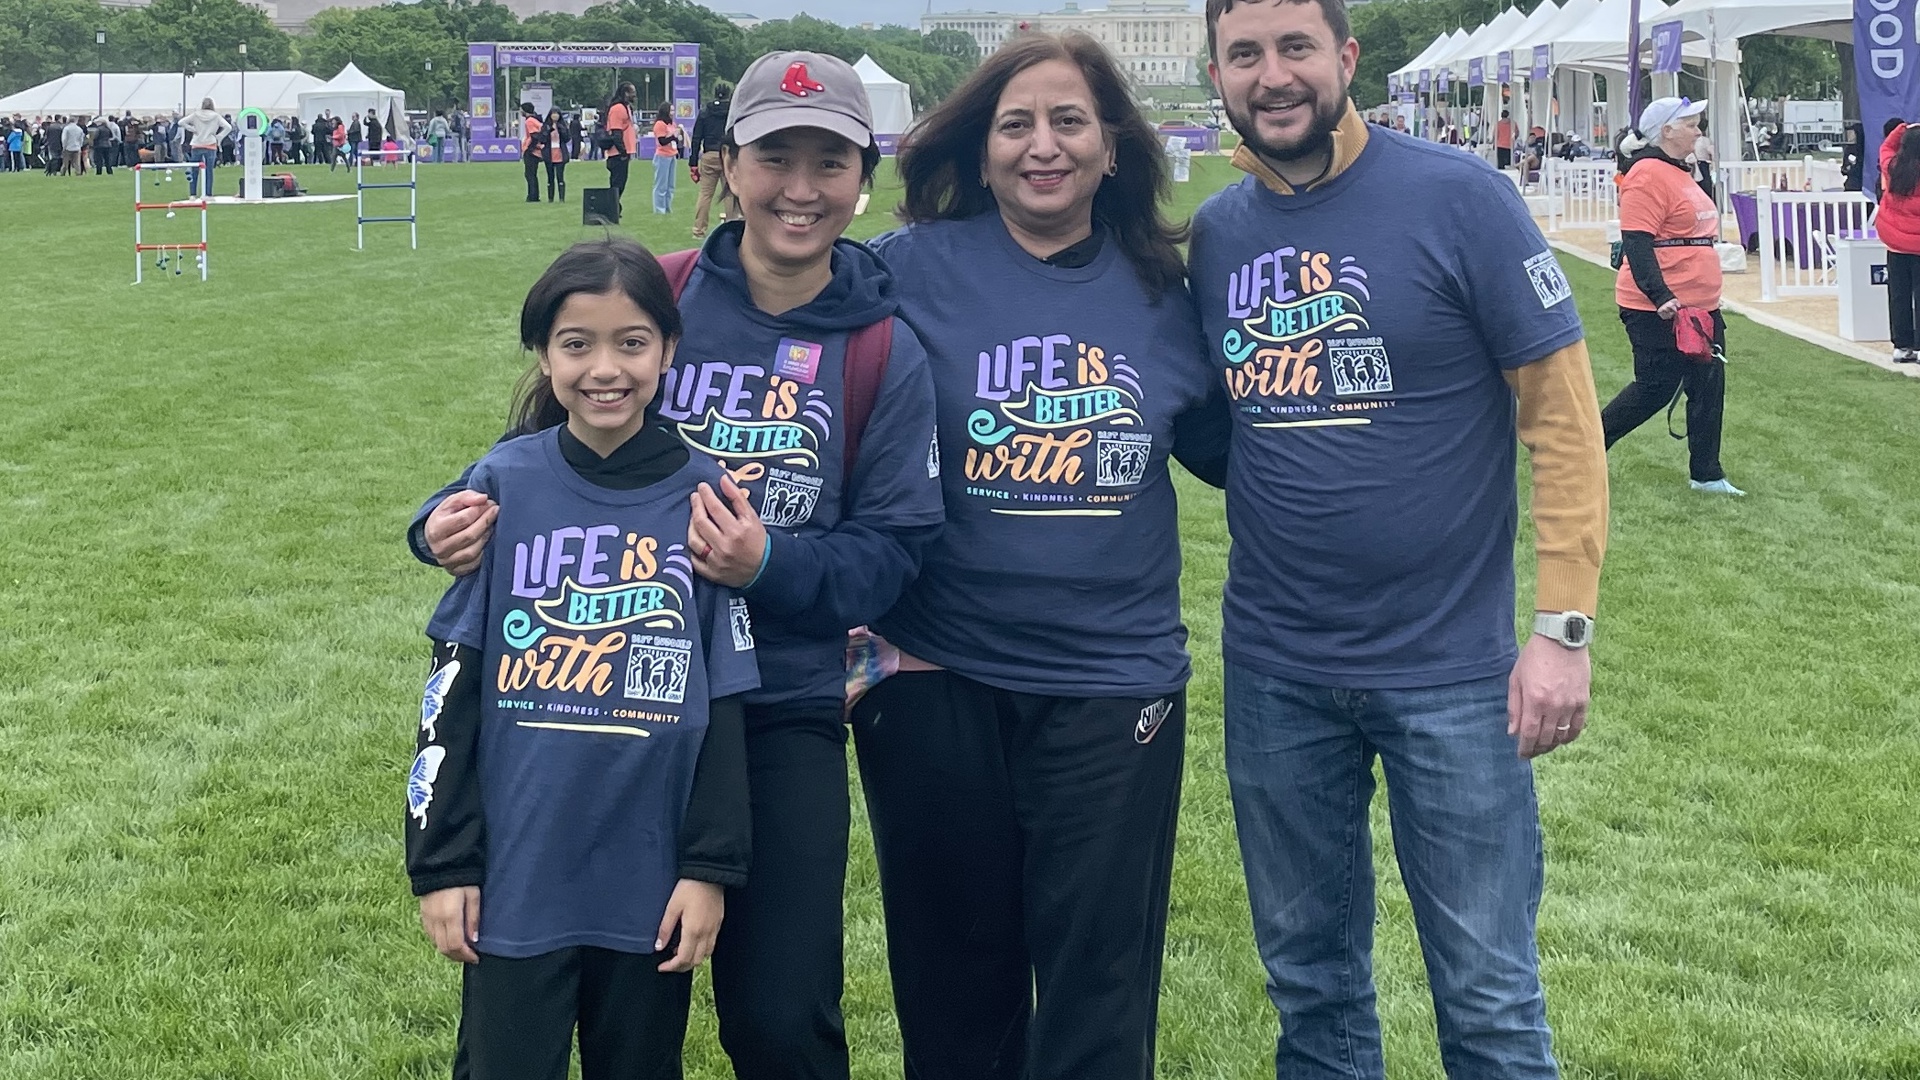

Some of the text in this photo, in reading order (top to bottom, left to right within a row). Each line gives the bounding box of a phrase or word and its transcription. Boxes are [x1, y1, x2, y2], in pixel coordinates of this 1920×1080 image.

[576, 56, 629, 64] FRIENDSHIP
[631, 56, 655, 64] WALK
[1228, 246, 1296, 318] LIFE
[1271, 295, 1346, 336] BETTER
[975, 334, 1071, 401] LIFE
[1225, 338, 1324, 400] with
[659, 362, 765, 421] LIFE
[1035, 390, 1122, 424] BETTER
[1330, 401, 1396, 412] COMMUNITY
[710, 421, 803, 452] BETTER
[964, 428, 1092, 485] with
[966, 486, 1142, 503] SERVICE KINDNESS COMMUNI
[511, 525, 620, 598] LIFE
[568, 586, 665, 625] BETTER
[497, 631, 627, 697] with
[497, 699, 681, 724] SERVICE KINDNESS COMMUNITY
